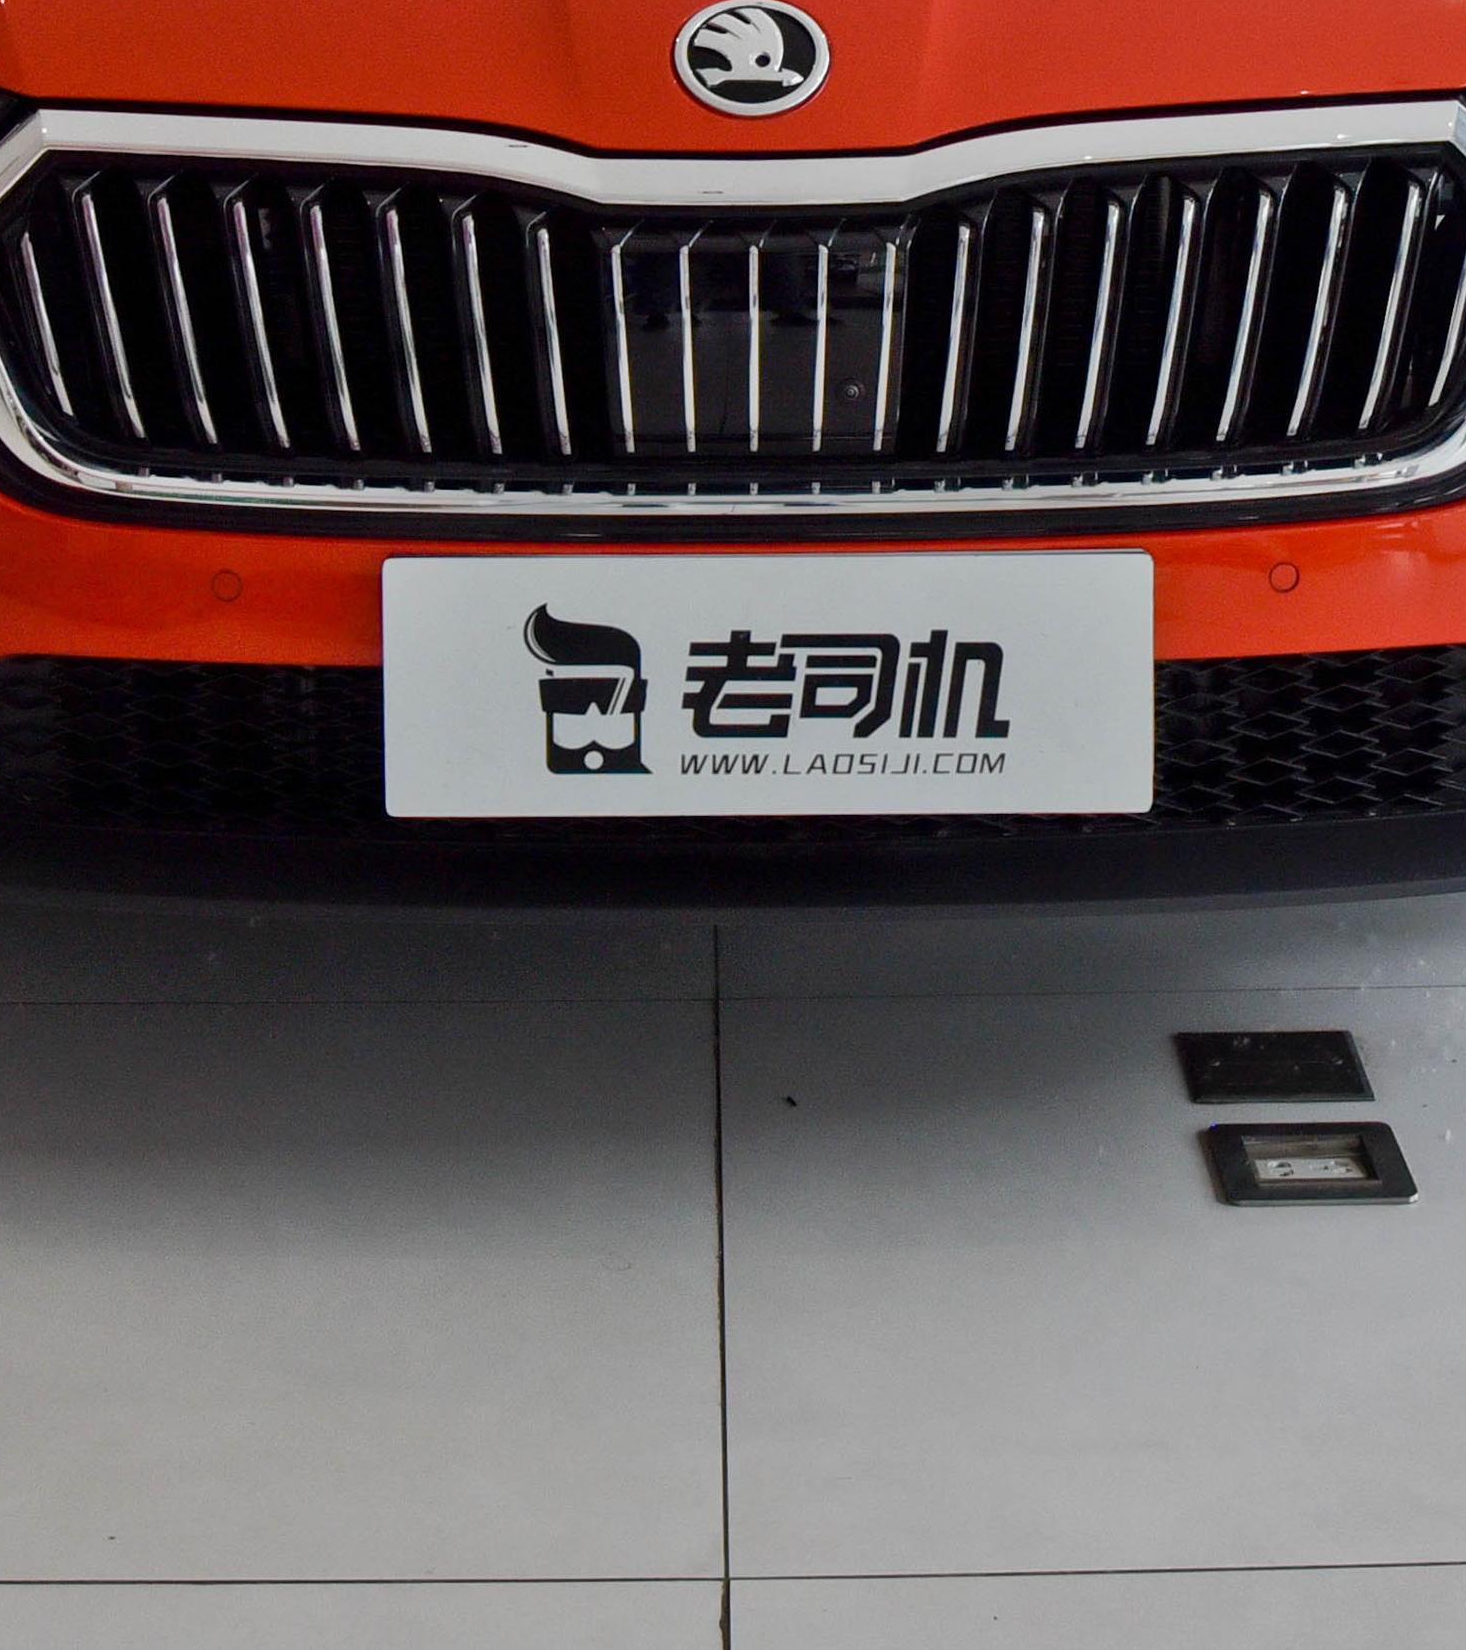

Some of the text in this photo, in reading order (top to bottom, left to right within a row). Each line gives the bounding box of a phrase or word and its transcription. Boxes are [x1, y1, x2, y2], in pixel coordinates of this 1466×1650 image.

[681, 629, 1010, 740] 老司机
[680, 752, 1006, 776] WWW.LAOSIJI.COM
